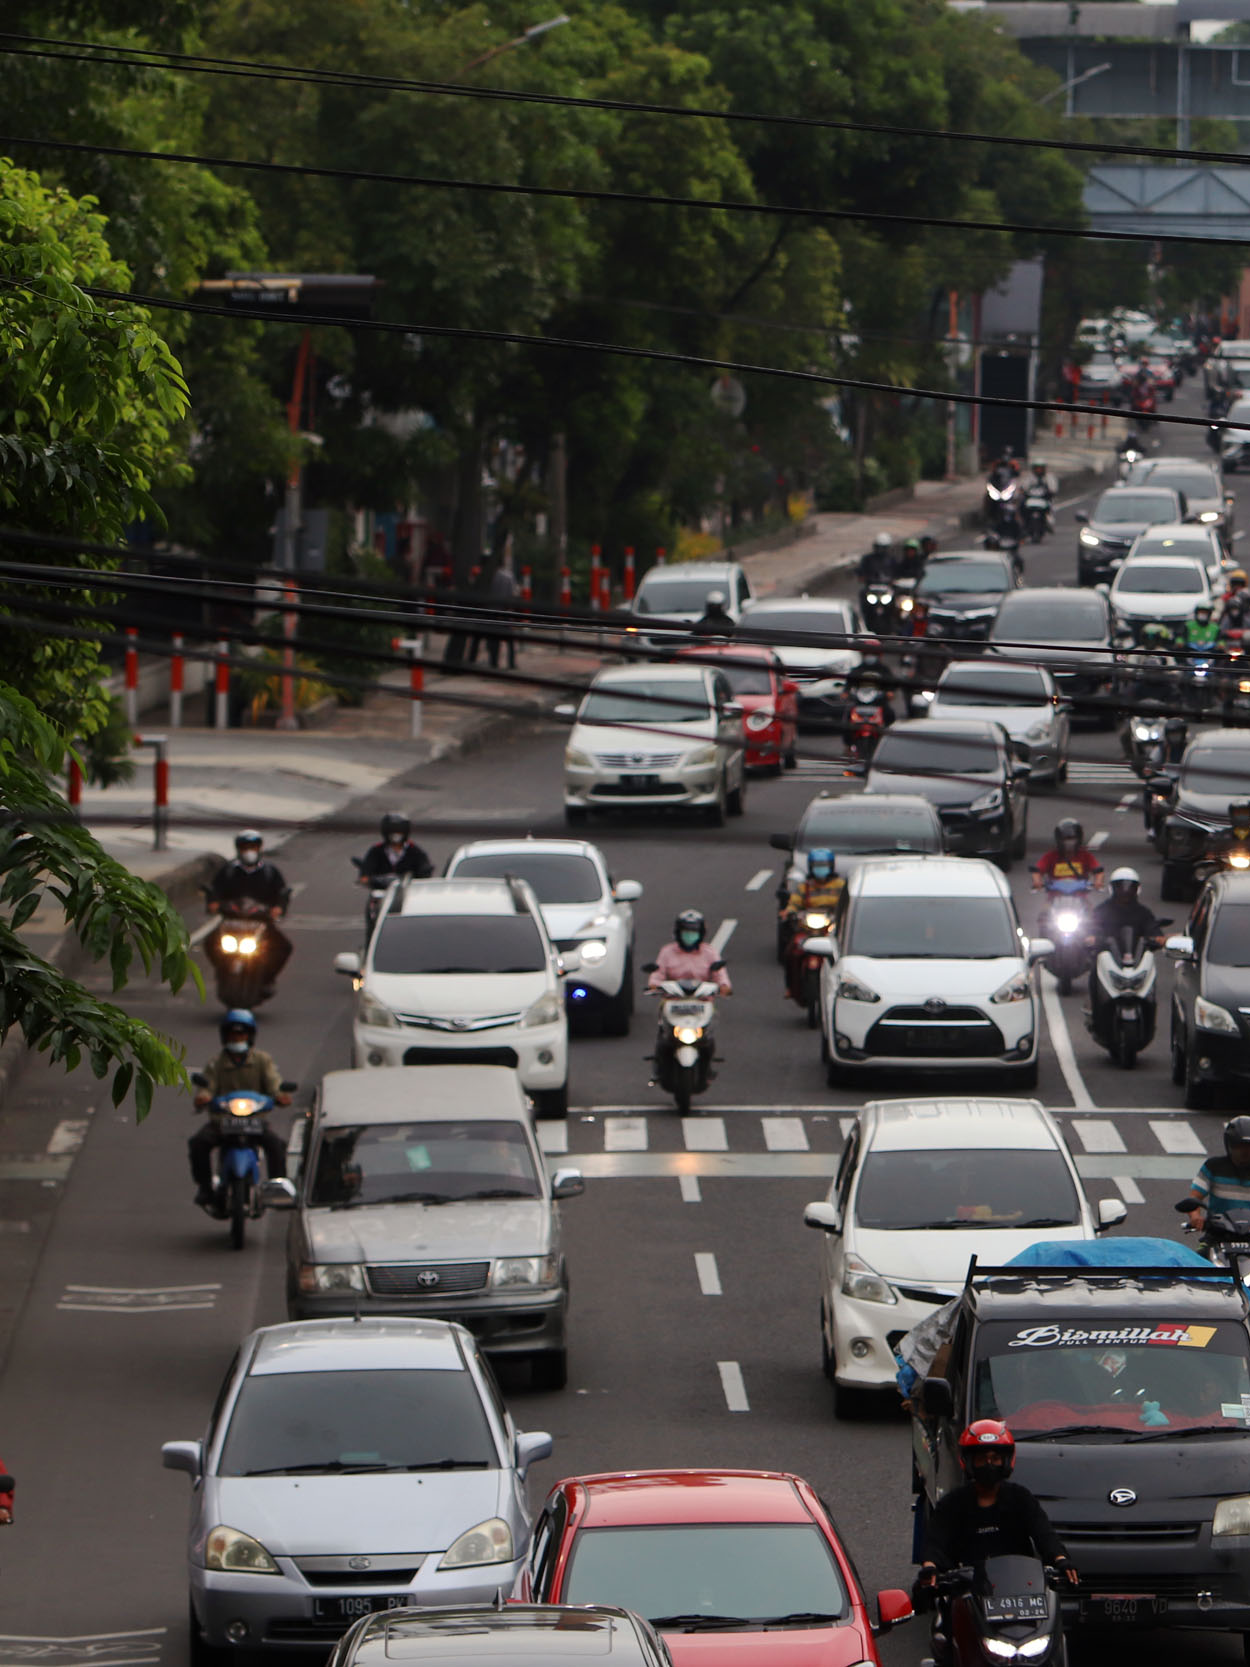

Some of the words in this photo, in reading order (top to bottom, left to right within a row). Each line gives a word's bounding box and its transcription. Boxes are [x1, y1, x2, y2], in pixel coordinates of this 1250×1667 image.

[1008, 1324, 1192, 1347] Bismillah
[315, 1599, 324, 1616] L
[340, 1598, 372, 1616] 1095
[987, 1600, 994, 1610] L
[1104, 1599, 1137, 1615] 9640
